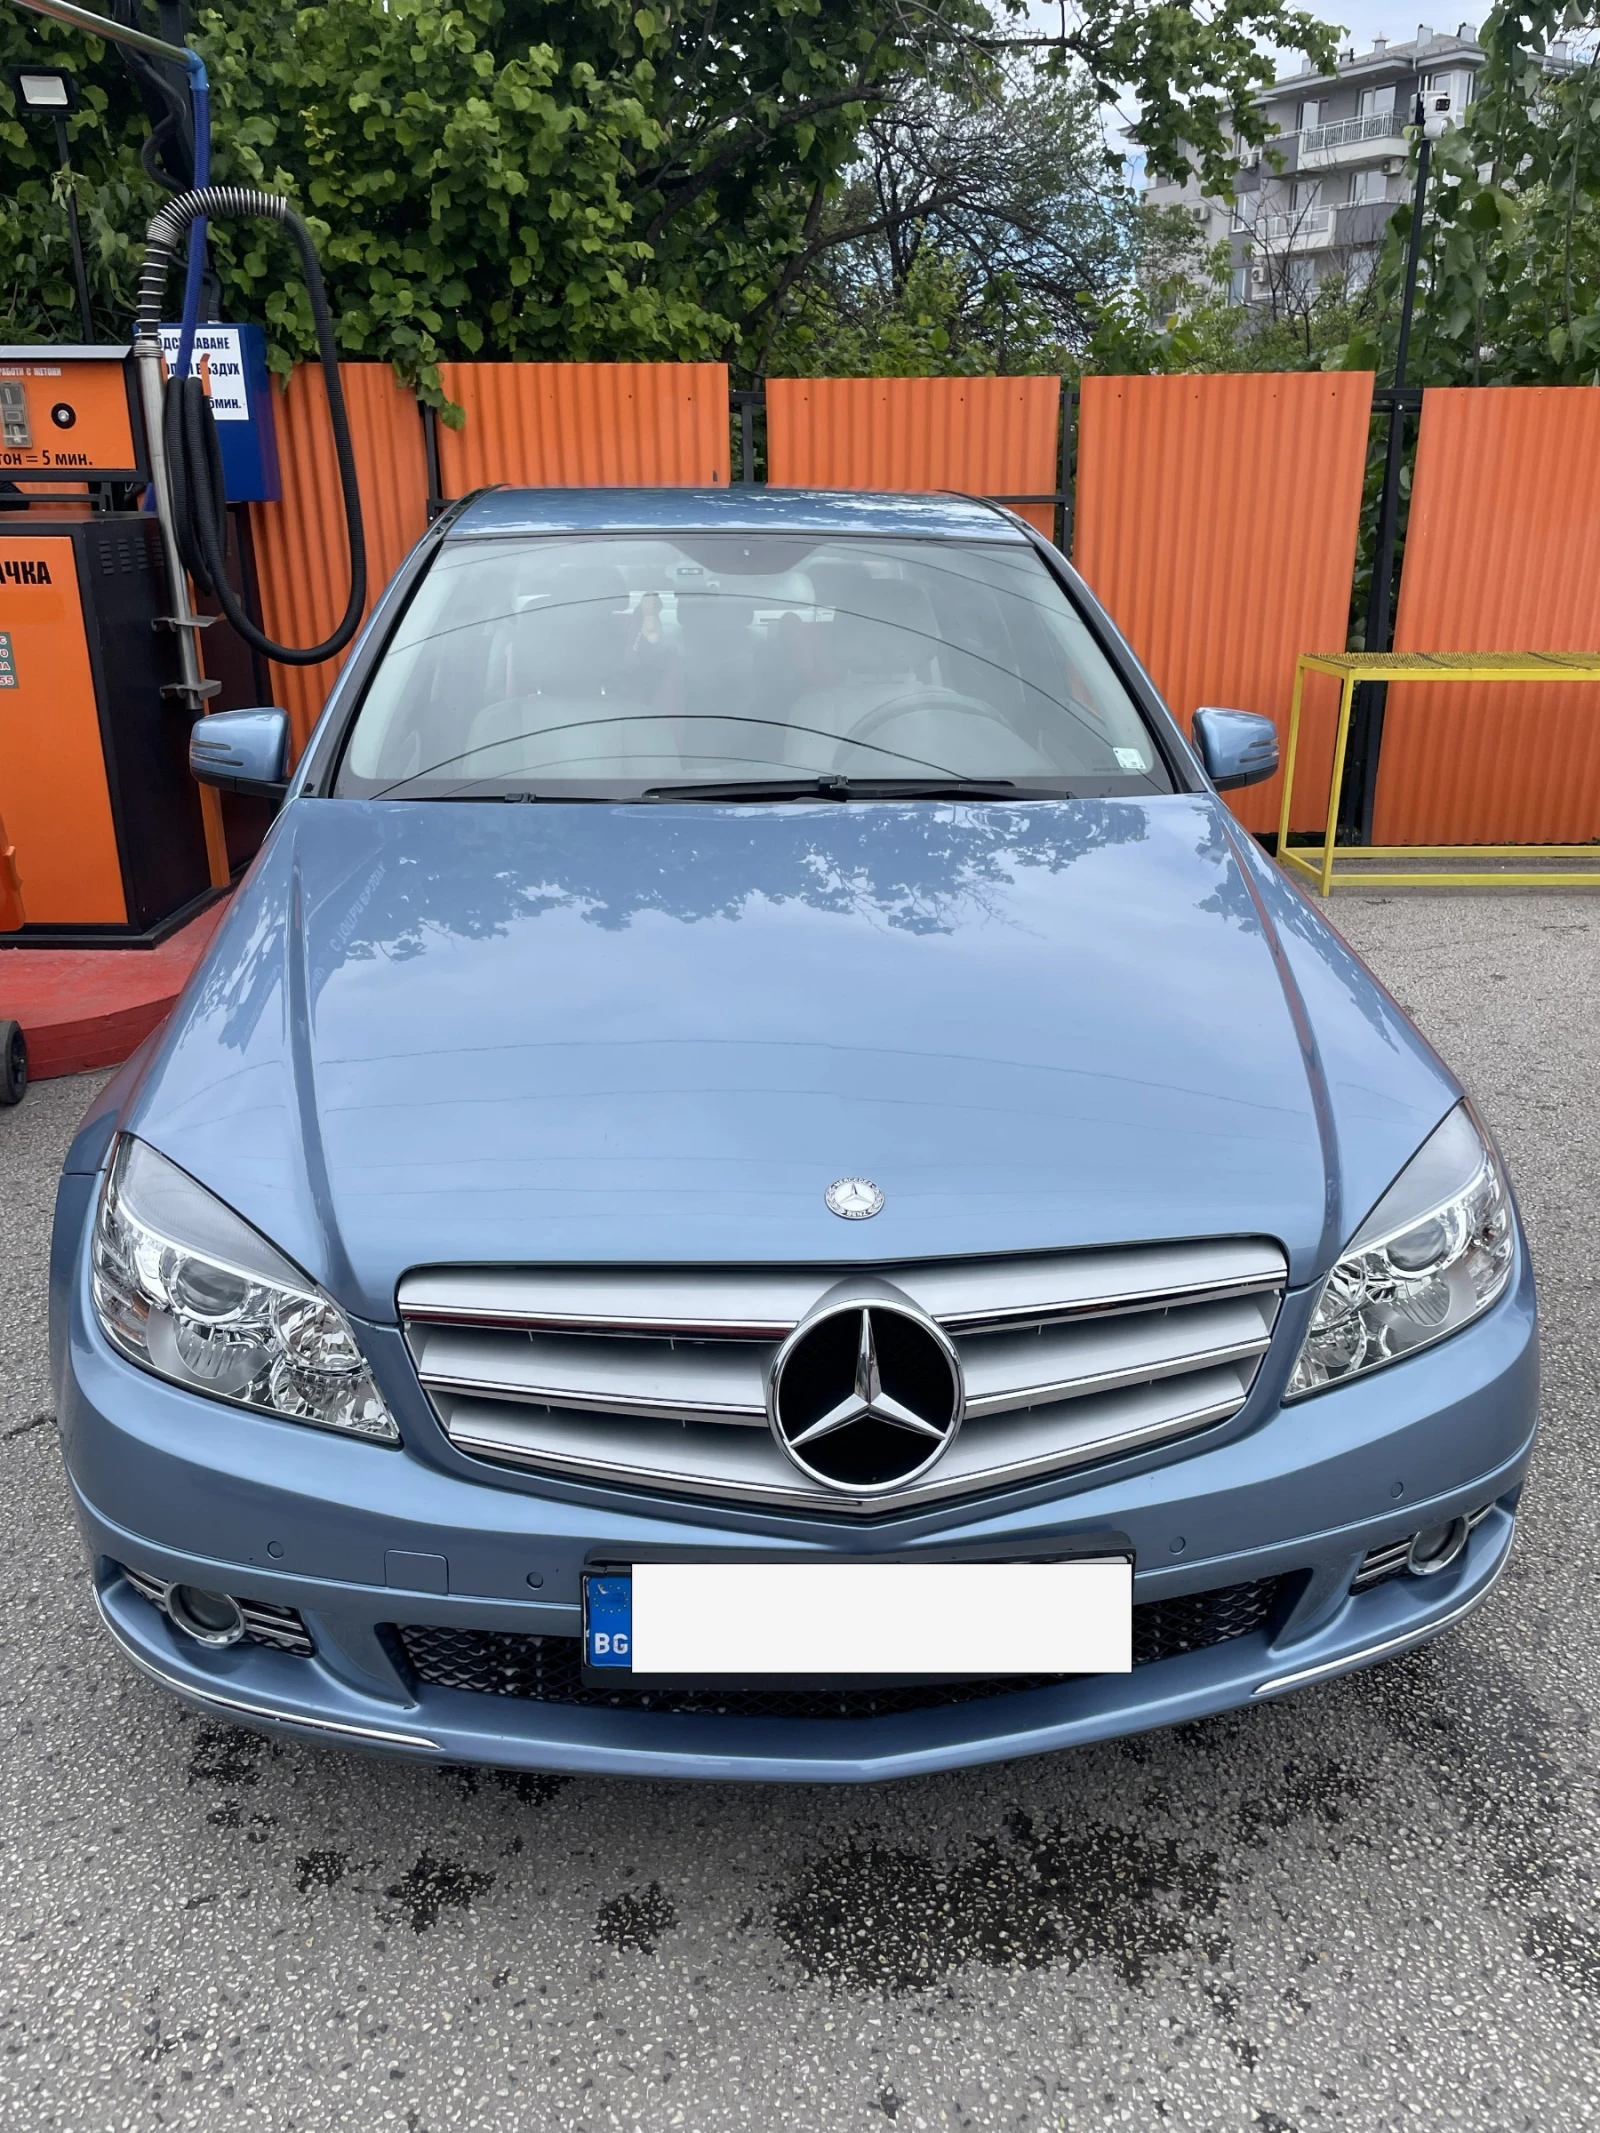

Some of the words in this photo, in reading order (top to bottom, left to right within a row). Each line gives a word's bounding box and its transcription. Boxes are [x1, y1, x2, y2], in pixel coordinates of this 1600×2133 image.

[156, 337, 230, 351] ОДСАВАНЕ
[26, 367, 32, 376] С
[42, 450, 50, 465] 5
[594, 1632, 628, 1654] BG
